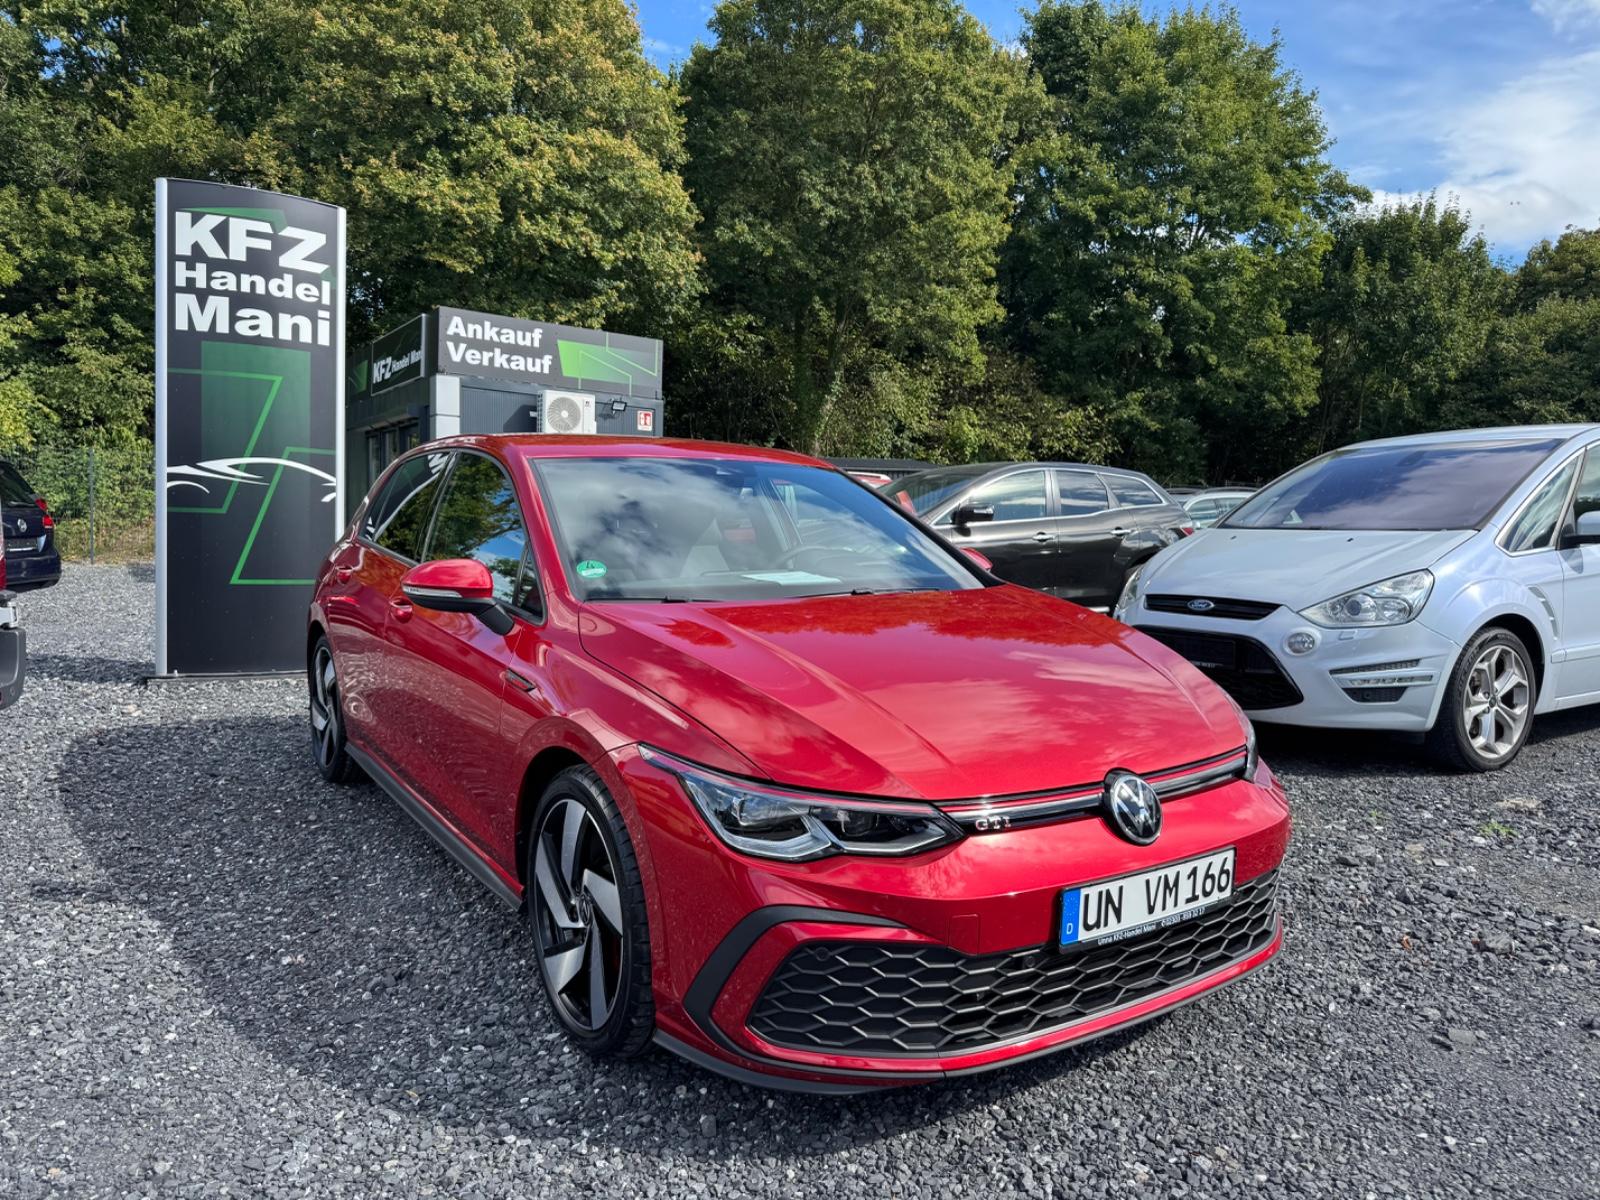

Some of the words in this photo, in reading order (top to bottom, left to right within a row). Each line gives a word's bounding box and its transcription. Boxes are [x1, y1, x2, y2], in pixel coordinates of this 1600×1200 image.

[175, 211, 331, 274] KFZ
[175, 261, 331, 306] Handel
[175, 293, 330, 347] Mani
[446, 315, 543, 348] Ankauf
[373, 356, 392, 384] KFZ
[446, 341, 552, 374] Verkauf
[976, 815, 1011, 831] GTI
[1082, 885, 1124, 932] UN
[1066, 923, 1073, 935] D
